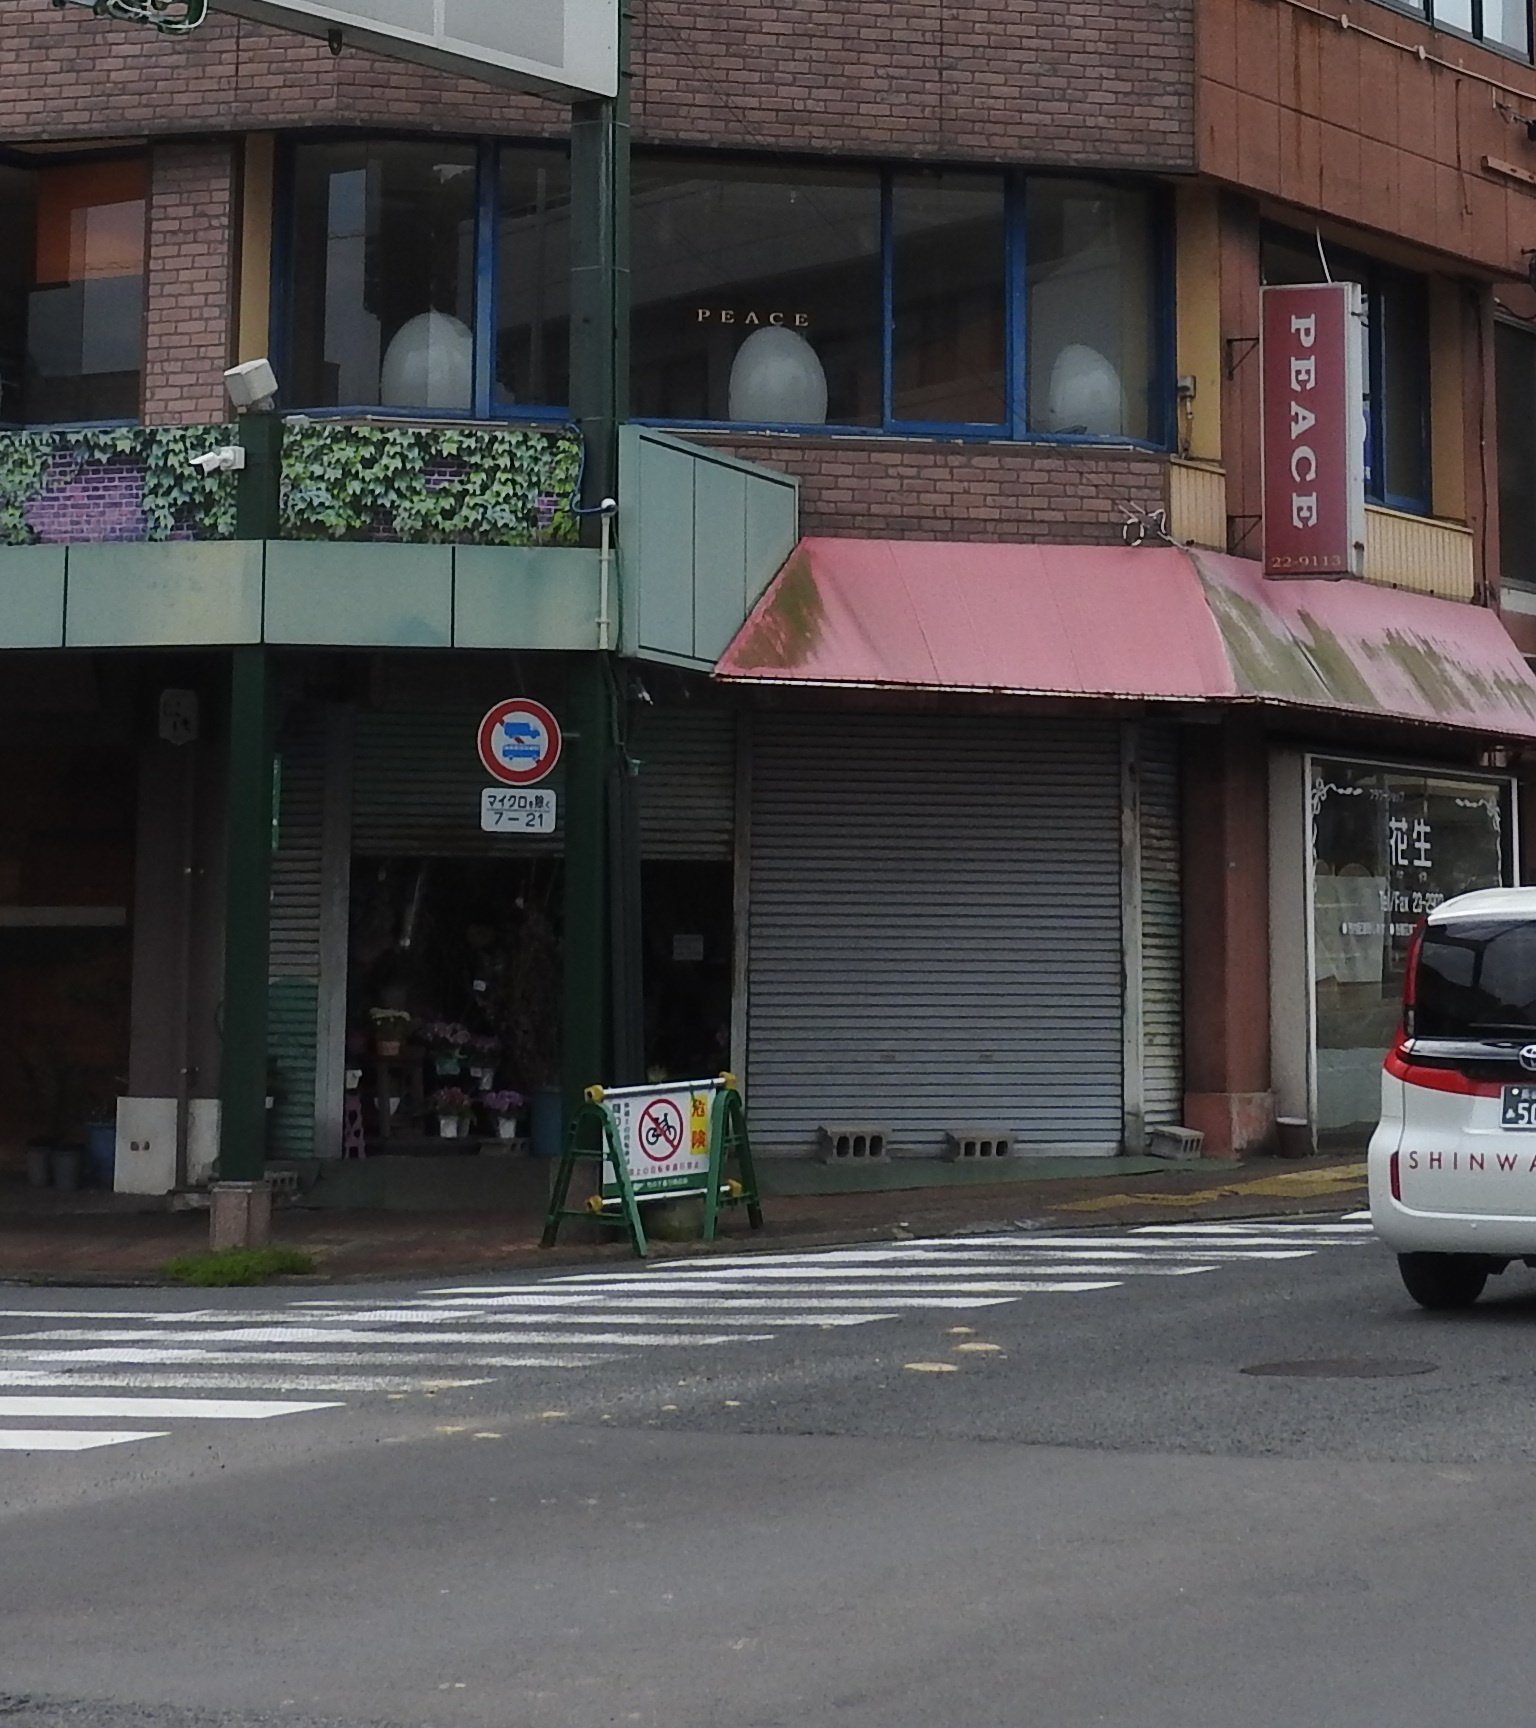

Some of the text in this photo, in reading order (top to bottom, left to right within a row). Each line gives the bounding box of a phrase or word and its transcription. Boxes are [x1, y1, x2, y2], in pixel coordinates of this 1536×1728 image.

[697, 308, 811, 328] PEACE
[1290, 313, 1318, 529] PEACE
[1272, 554, 1341, 568] 22-9113
[487, 794, 550, 808] マイクロを除く
[1389, 816, 1432, 868] 花生
